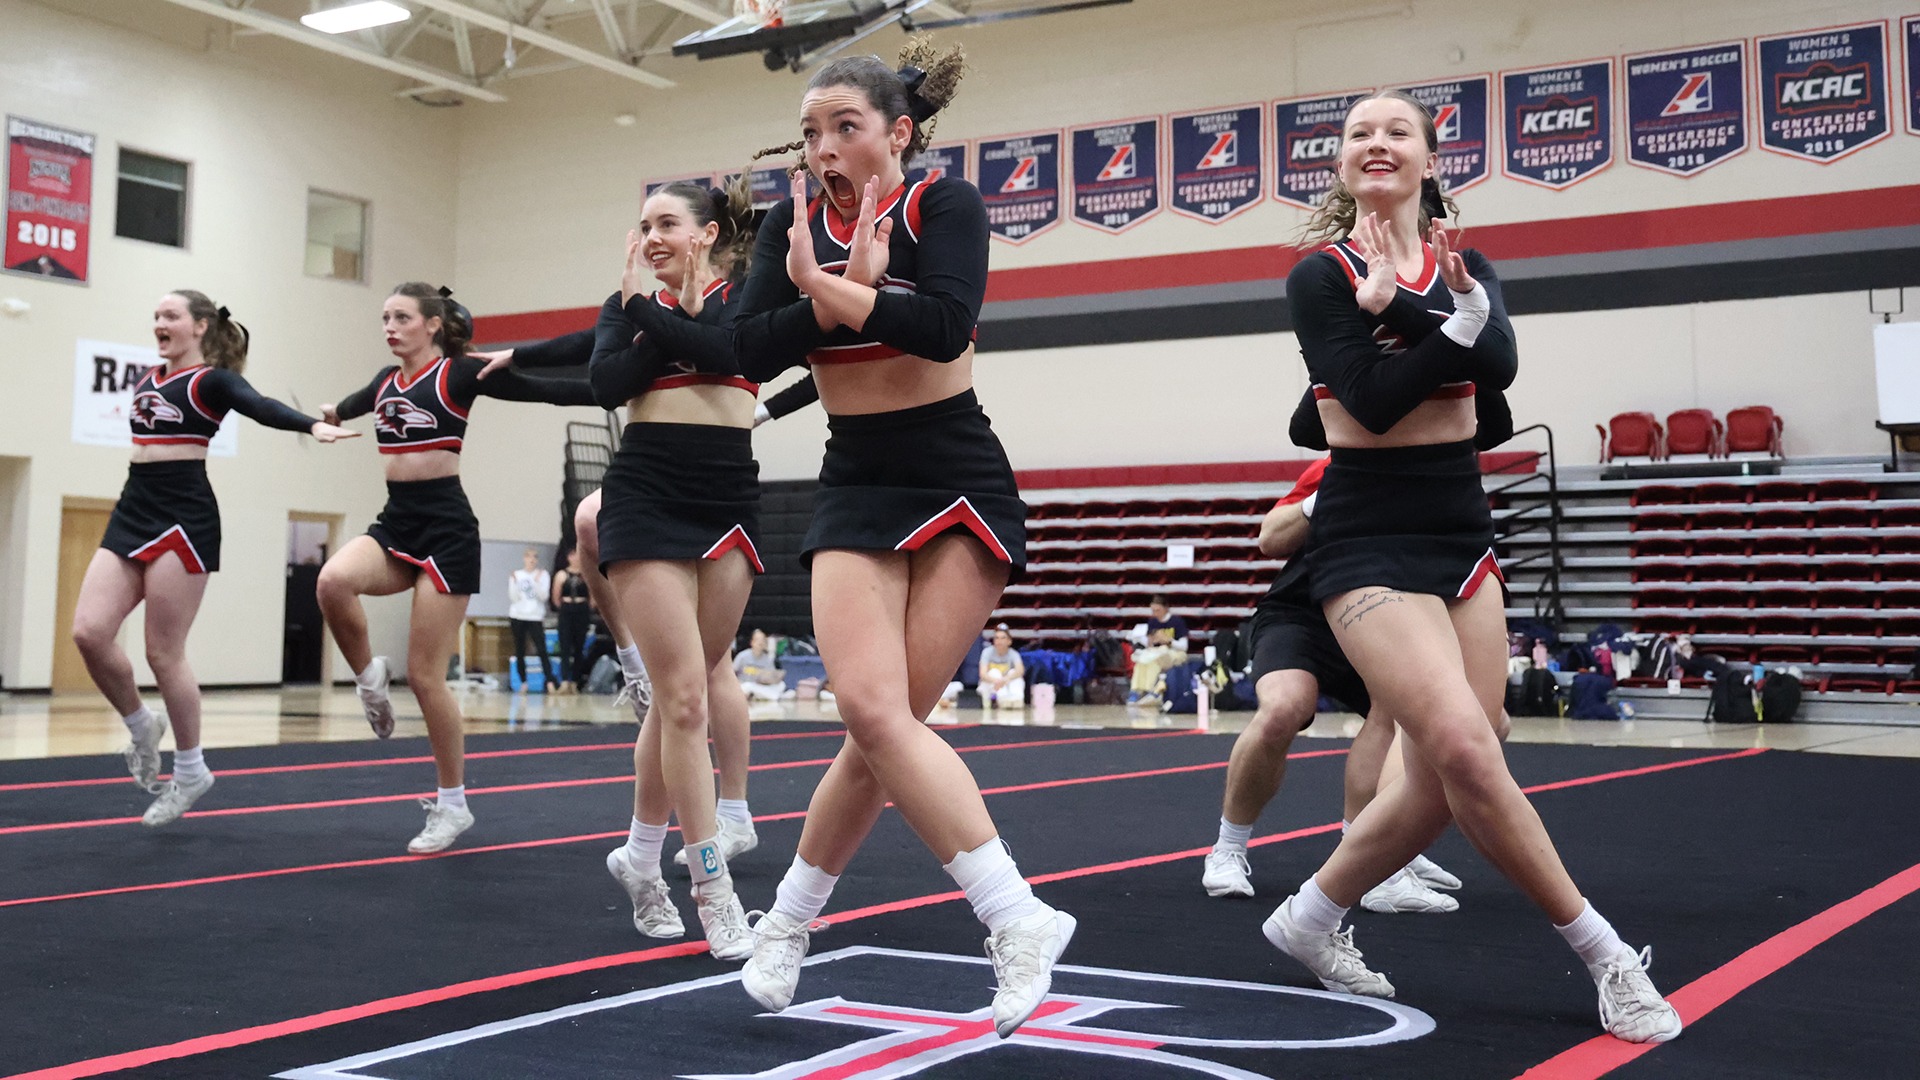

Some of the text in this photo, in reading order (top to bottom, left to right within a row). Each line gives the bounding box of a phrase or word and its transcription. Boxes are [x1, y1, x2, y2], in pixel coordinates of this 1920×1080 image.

[1631, 51, 1738, 76] WOMEN'S SOCCER
[1786, 46, 1852, 64] LACROSSE
[1527, 81, 1584, 97] LACROSSE
[1781, 73, 1864, 104] KCAC
[1522, 106, 1593, 134] KCAC
[1772, 110, 1876, 131] CONFERENCE
[1638, 125, 1736, 146] CONFERENCE
[1782, 121, 1866, 139] CHAMPION
[1291, 136, 1340, 160] KCA
[1513, 140, 1603, 159] CONFERENCE
[1648, 136, 1727, 154] CHAMPION
[1804, 140, 1845, 154] 2016
[1522, 151, 1594, 167] CHAMPION
[1543, 167, 1577, 181] 2017
[1179, 178, 1255, 195] CONFERENCE
[1186, 188, 1247, 203] CHAMPION
[1079, 189, 1152, 206] CONFERENCE
[1202, 202, 1230, 215] 2018
[17, 220, 77, 251] 2015
